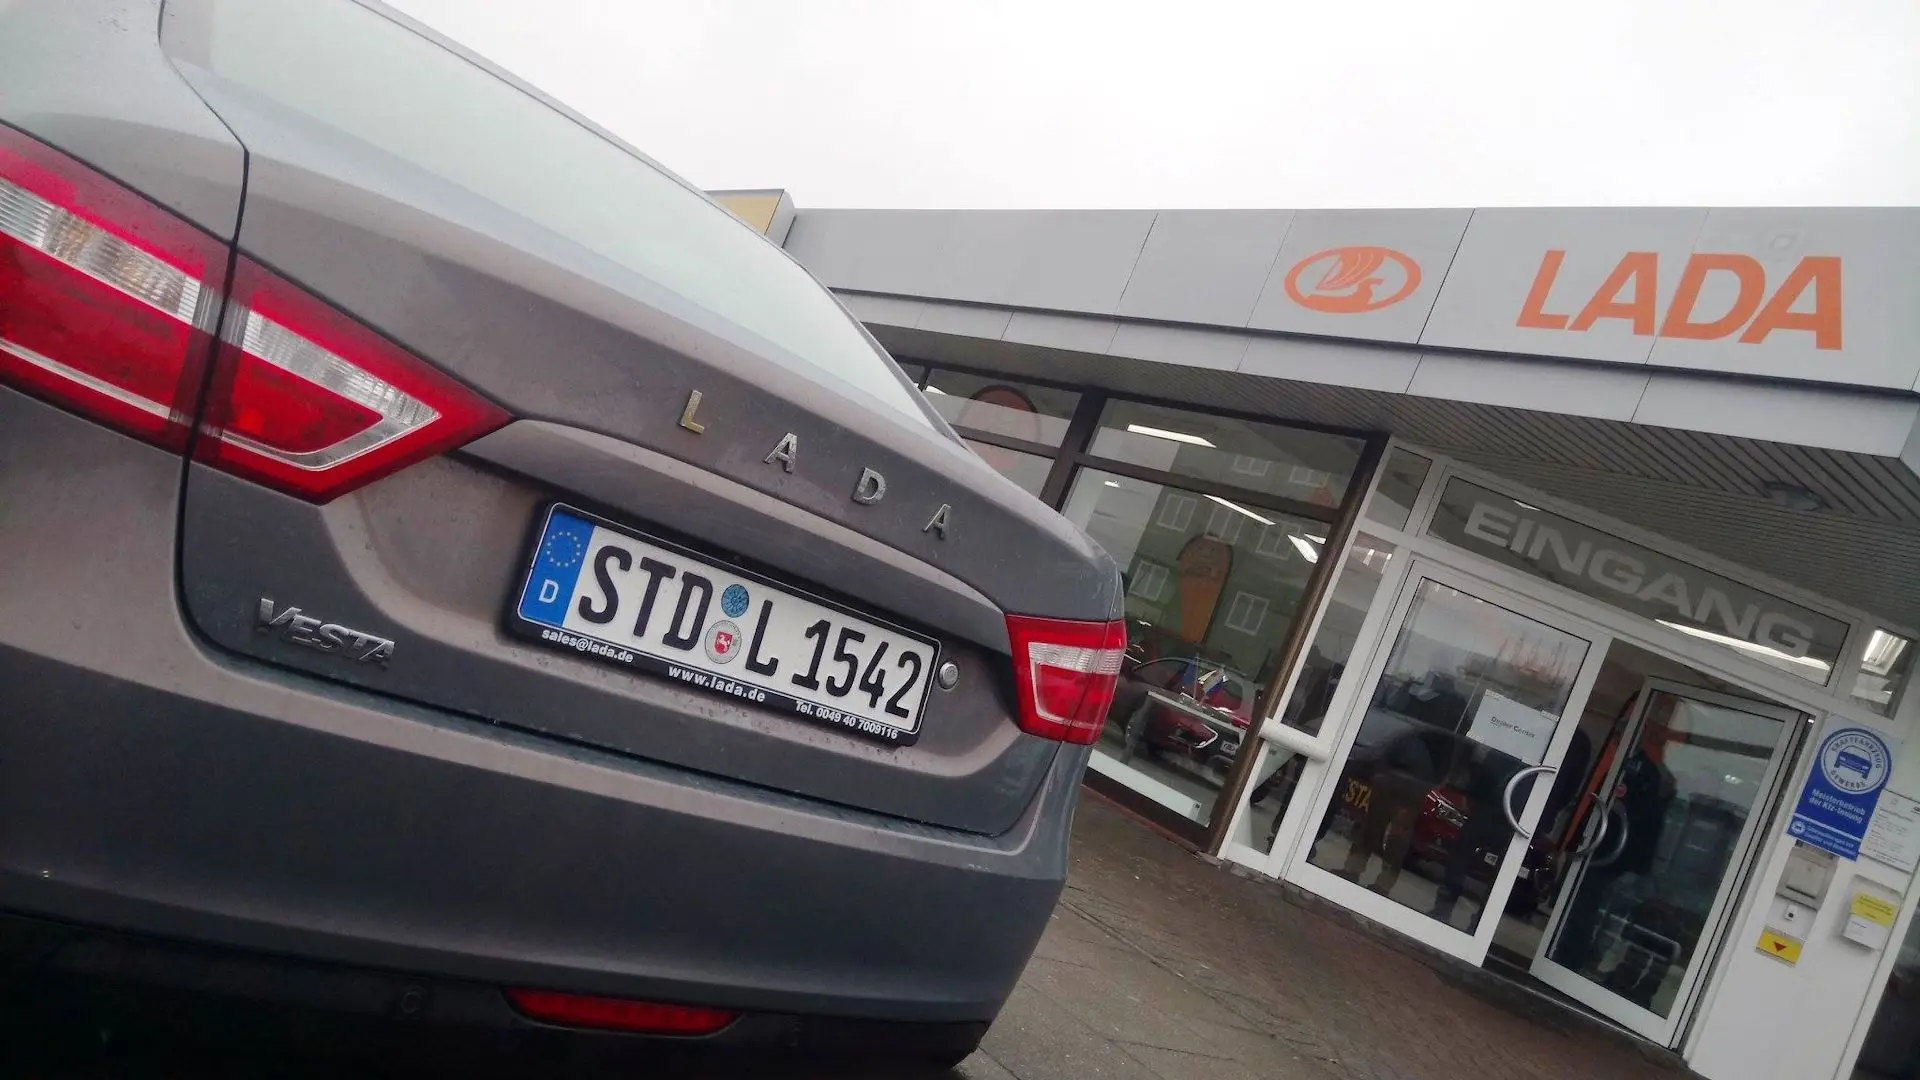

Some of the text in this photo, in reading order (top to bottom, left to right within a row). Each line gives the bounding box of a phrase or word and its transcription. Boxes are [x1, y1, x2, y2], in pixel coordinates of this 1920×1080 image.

[1515, 250, 1842, 350] LADA
[680, 389, 951, 540] LADA
[539, 579, 559, 604] D
[1463, 502, 1815, 659] EINGANG
[256, 598, 395, 669] VESTA
[541, 628, 634, 664] sales@lada.de
[578, 545, 922, 719] STD L 1542
[668, 666, 765, 702] www.lada.de
[795, 700, 898, 740] Tel. 0049 40 7009116
[1343, 778, 1372, 812] STA
